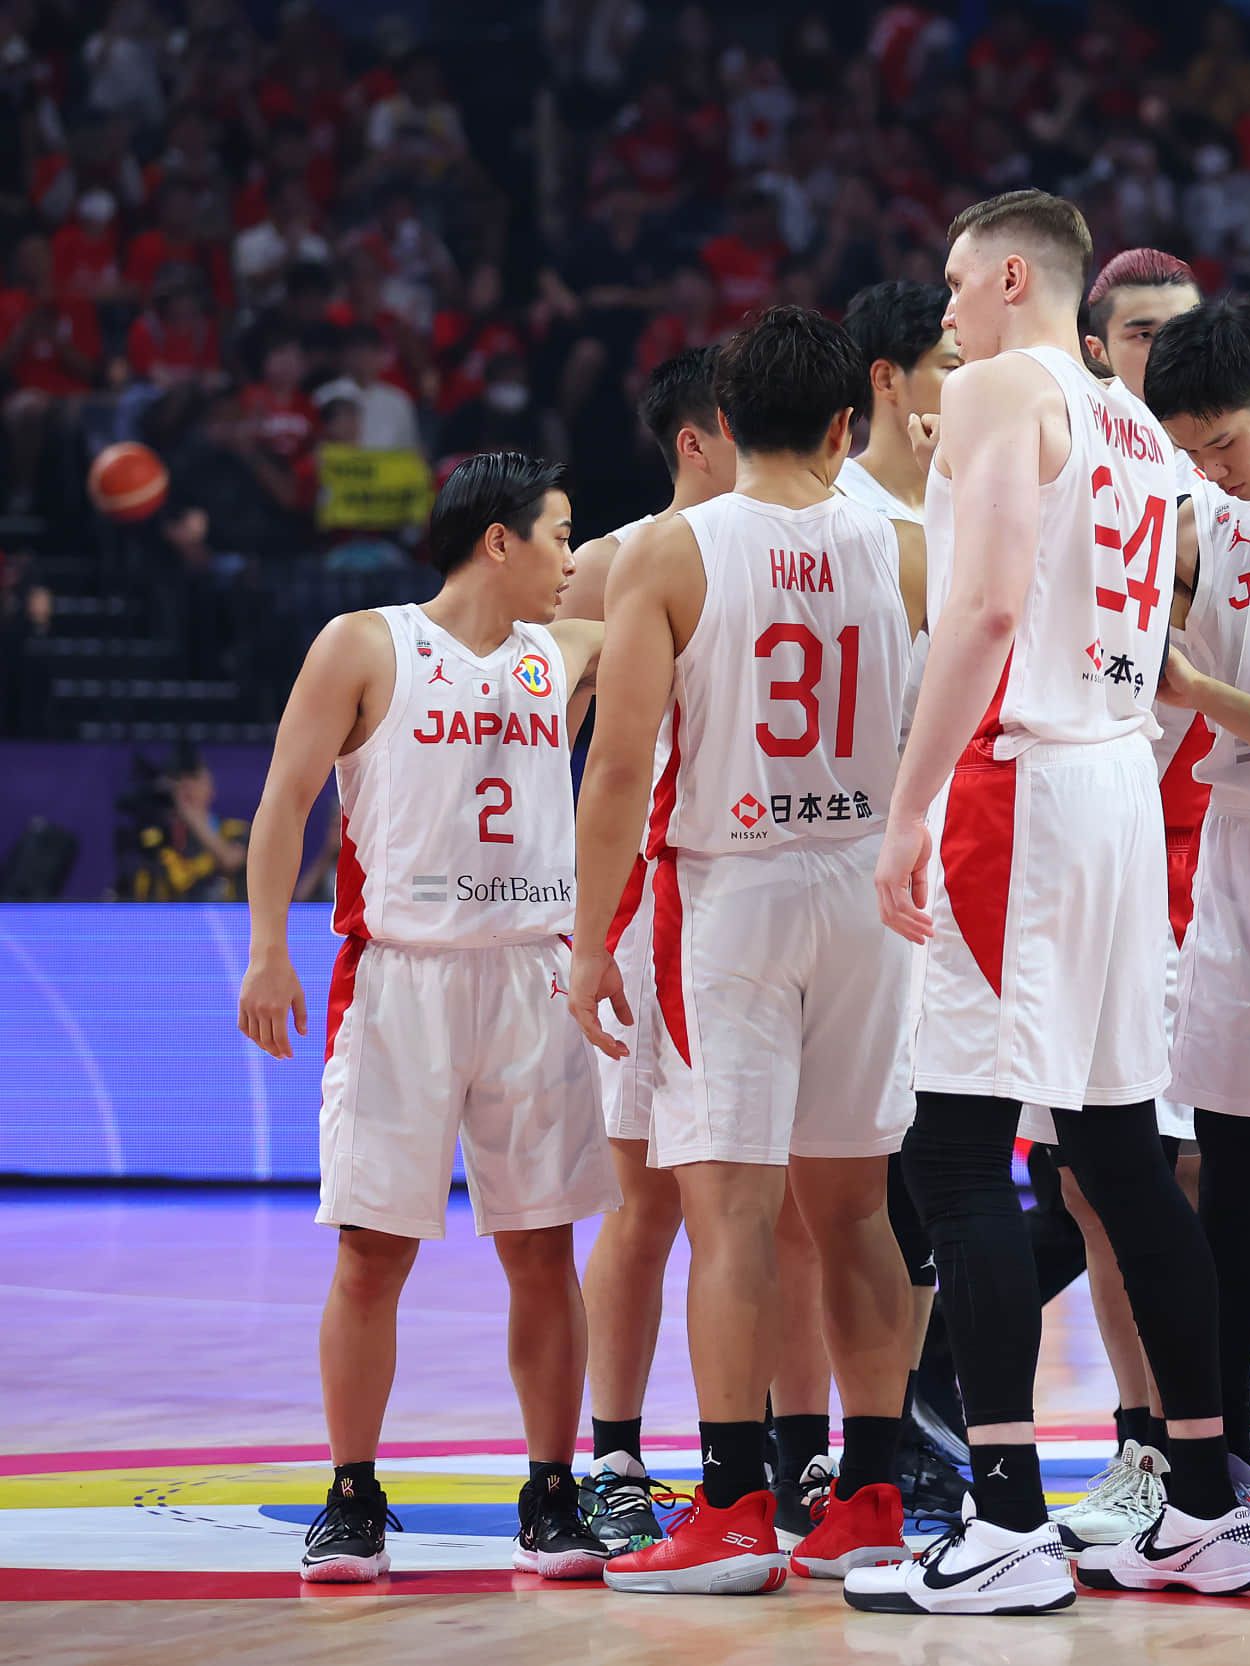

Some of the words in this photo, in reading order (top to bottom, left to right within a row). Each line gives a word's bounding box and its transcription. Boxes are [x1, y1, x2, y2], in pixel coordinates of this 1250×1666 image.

[769, 548, 834, 593] HARA
[754, 622, 860, 758] 31
[413, 710, 559, 748] JAPAN
[475, 777, 515, 844] 2
[769, 790, 873, 824] 日本生命
[730, 831, 768, 840] NISSAY
[456, 875, 572, 903] SoftBank
